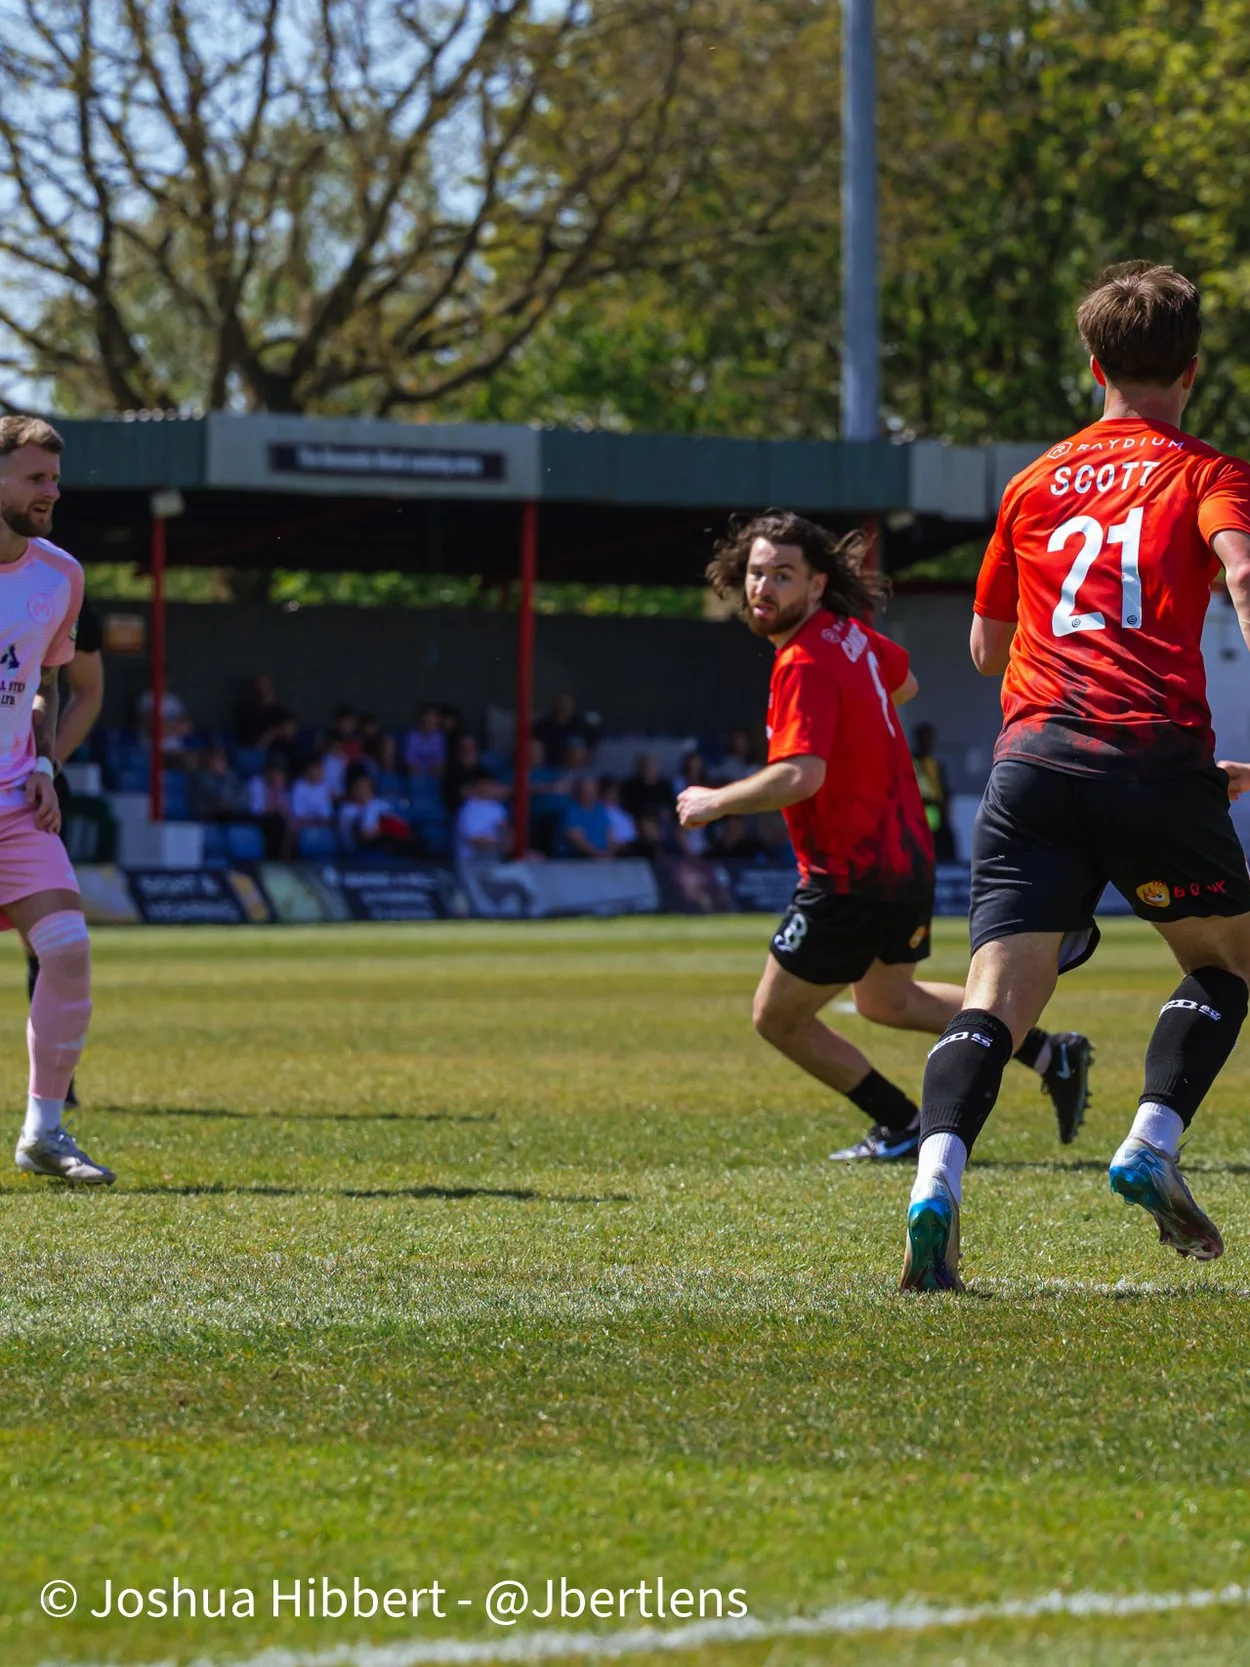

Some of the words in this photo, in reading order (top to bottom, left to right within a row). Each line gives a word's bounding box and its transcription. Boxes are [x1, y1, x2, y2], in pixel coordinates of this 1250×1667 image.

[1076, 436, 1184, 451] RAYDIUM
[1050, 460, 1161, 496] SCOTT
[1046, 506, 1143, 637] 21
